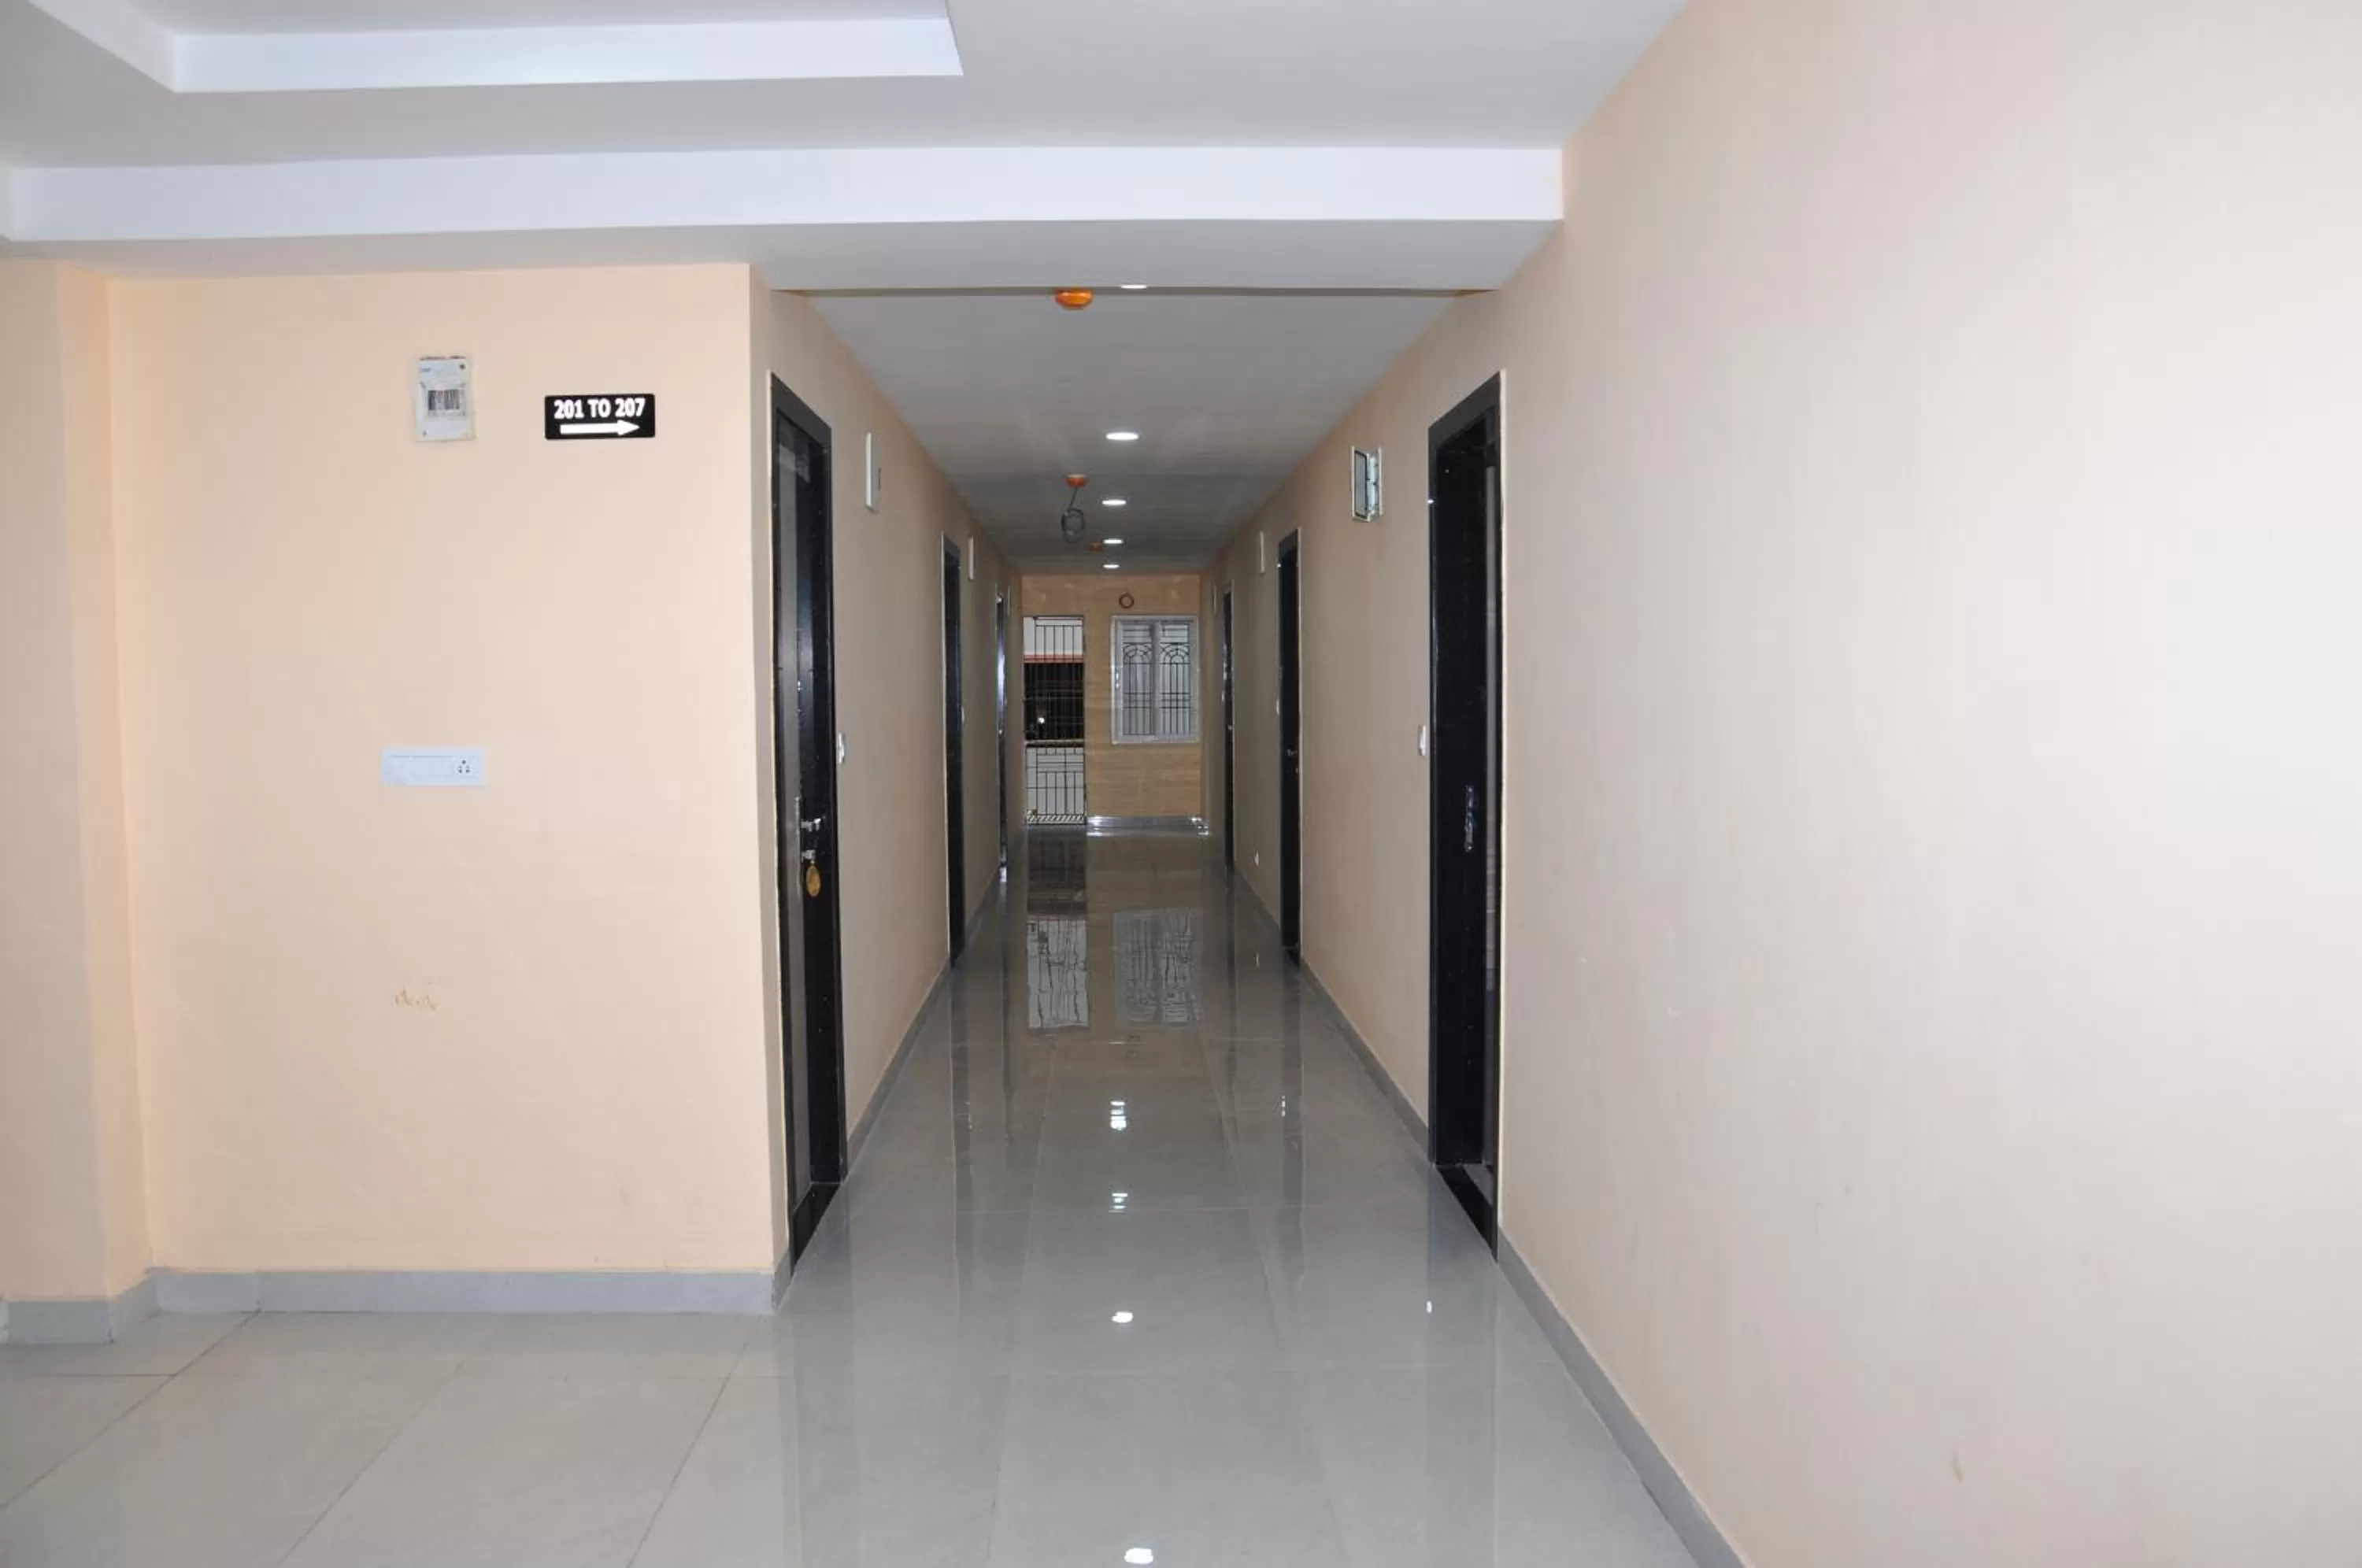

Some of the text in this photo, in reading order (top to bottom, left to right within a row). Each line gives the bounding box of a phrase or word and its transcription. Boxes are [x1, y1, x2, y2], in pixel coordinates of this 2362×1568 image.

[553, 398, 646, 420] 201 TO 207
